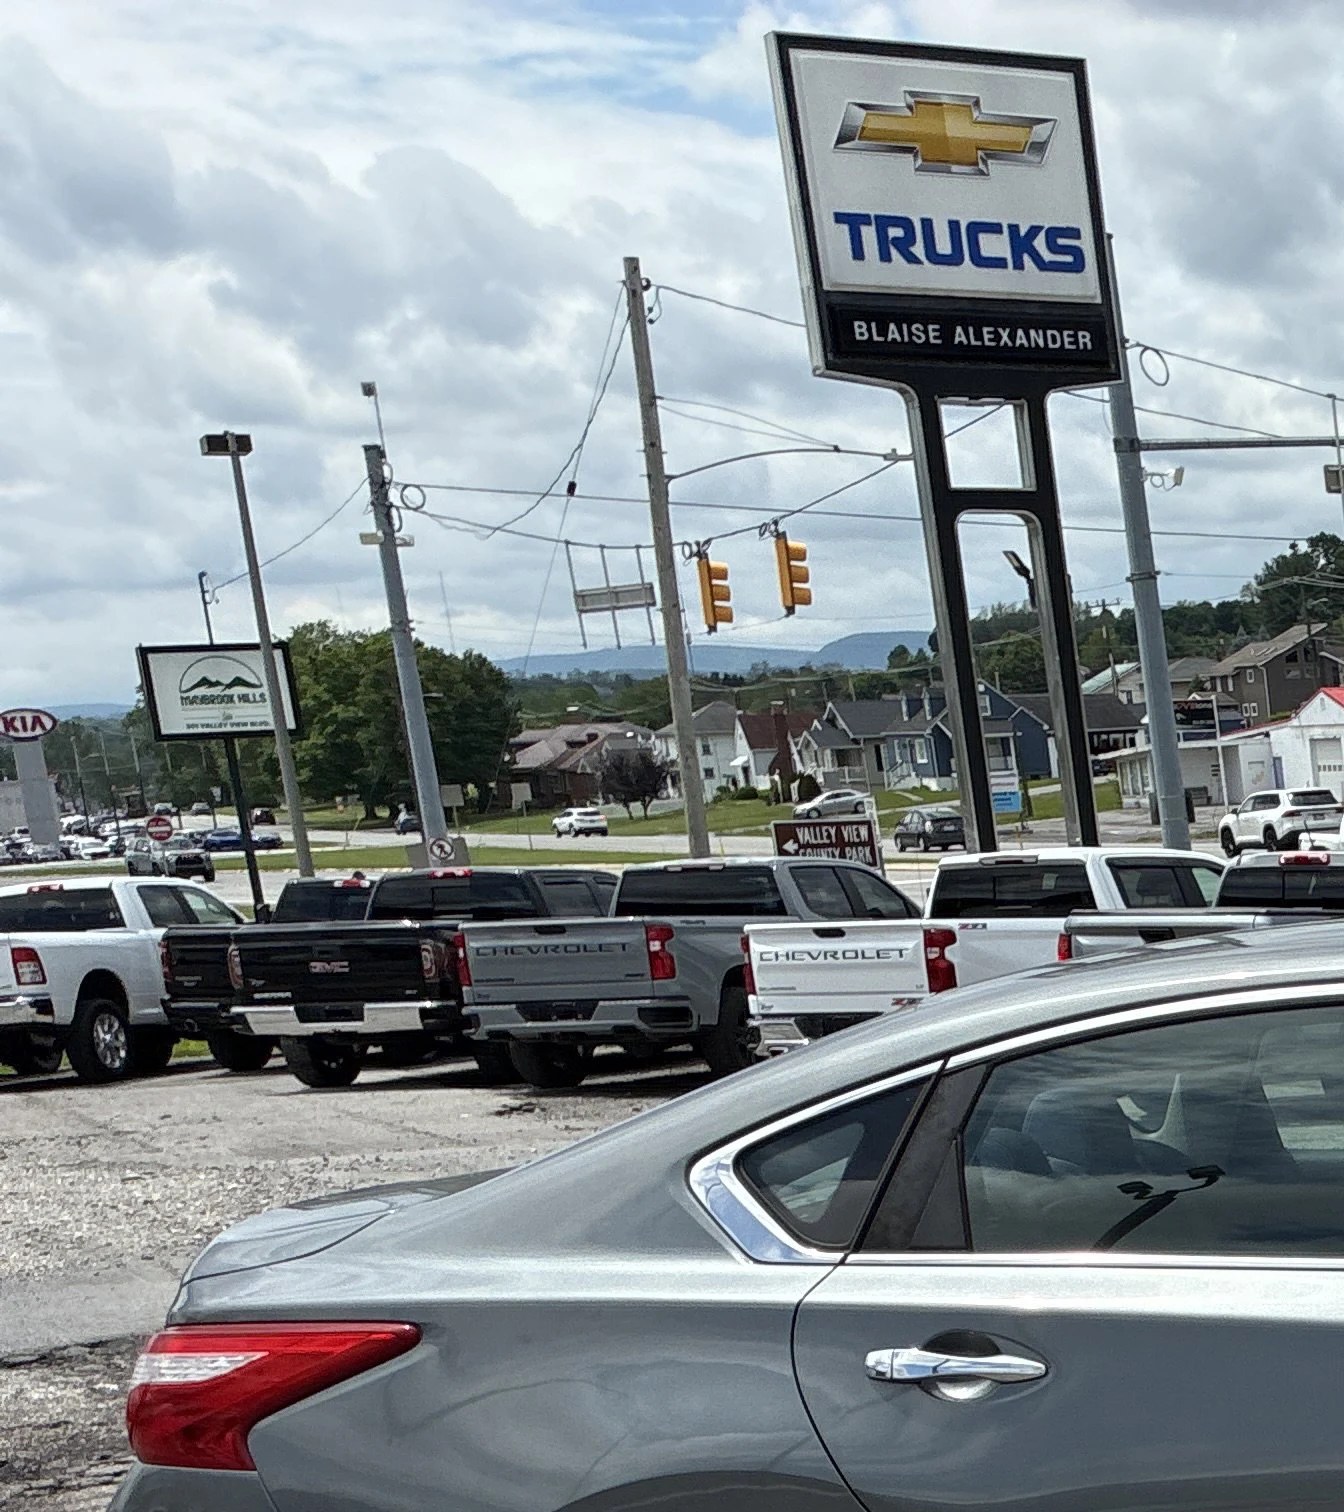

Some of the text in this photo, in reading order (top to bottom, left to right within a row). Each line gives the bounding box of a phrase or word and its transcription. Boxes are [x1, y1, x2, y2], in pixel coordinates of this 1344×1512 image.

[833, 212, 1085, 274] TRUCKS
[853, 320, 1093, 351] BLAISE ALEXANDER
[1, 715, 48, 733] KIA
[796, 824, 869, 845] VALLEY VIEW
[798, 846, 873, 864] COUNTY PARK
[475, 942, 628, 957] CHEVROLET
[759, 948, 909, 962] CHEVROLET
[308, 961, 350, 973] GMC
